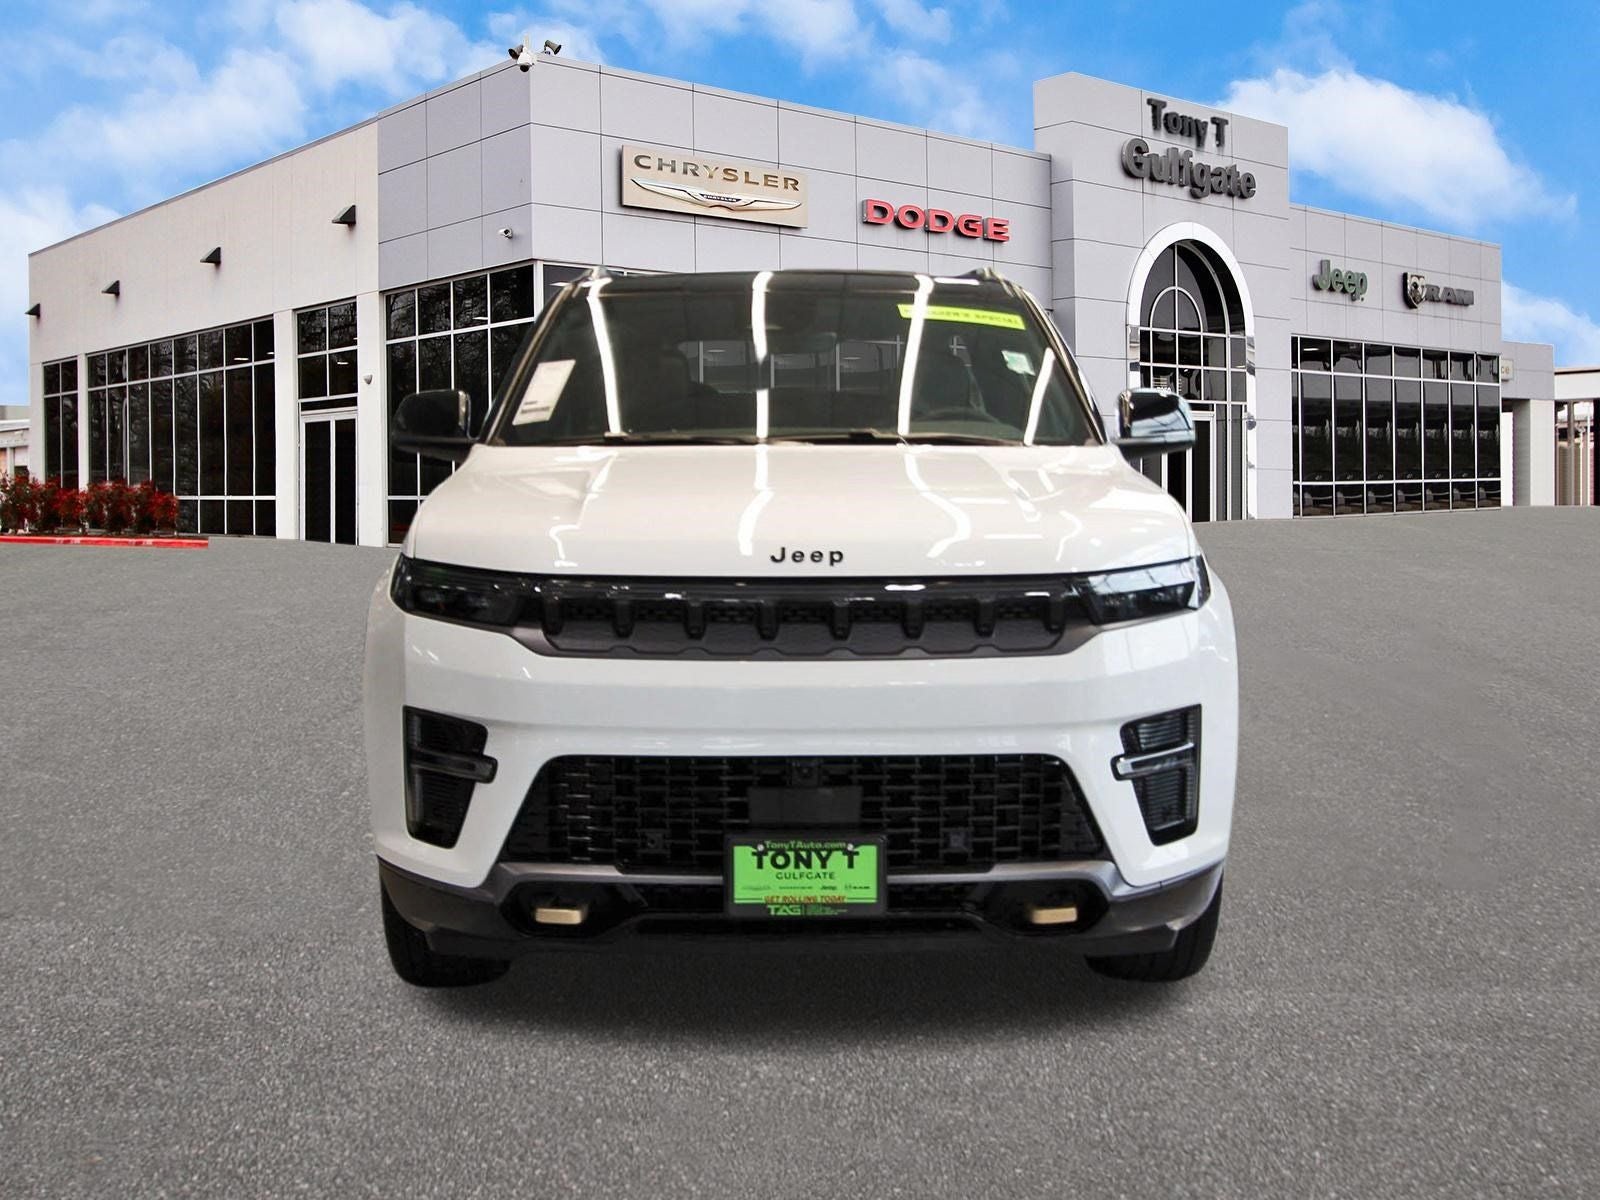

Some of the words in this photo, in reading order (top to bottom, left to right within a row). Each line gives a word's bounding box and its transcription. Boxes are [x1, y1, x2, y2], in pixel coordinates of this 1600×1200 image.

[1147, 98, 1208, 148] Tony
[1211, 117, 1229, 147] T
[633, 154, 800, 191] CHRYSLER
[1121, 137, 1257, 199] Gulfgate
[862, 198, 1010, 242] DODGE
[1312, 259, 1368, 301] Jeep
[1425, 283, 1475, 306] RAM
[770, 546, 844, 567] Jeep
[752, 850, 833, 870] TONY
[842, 849, 860, 870] T
